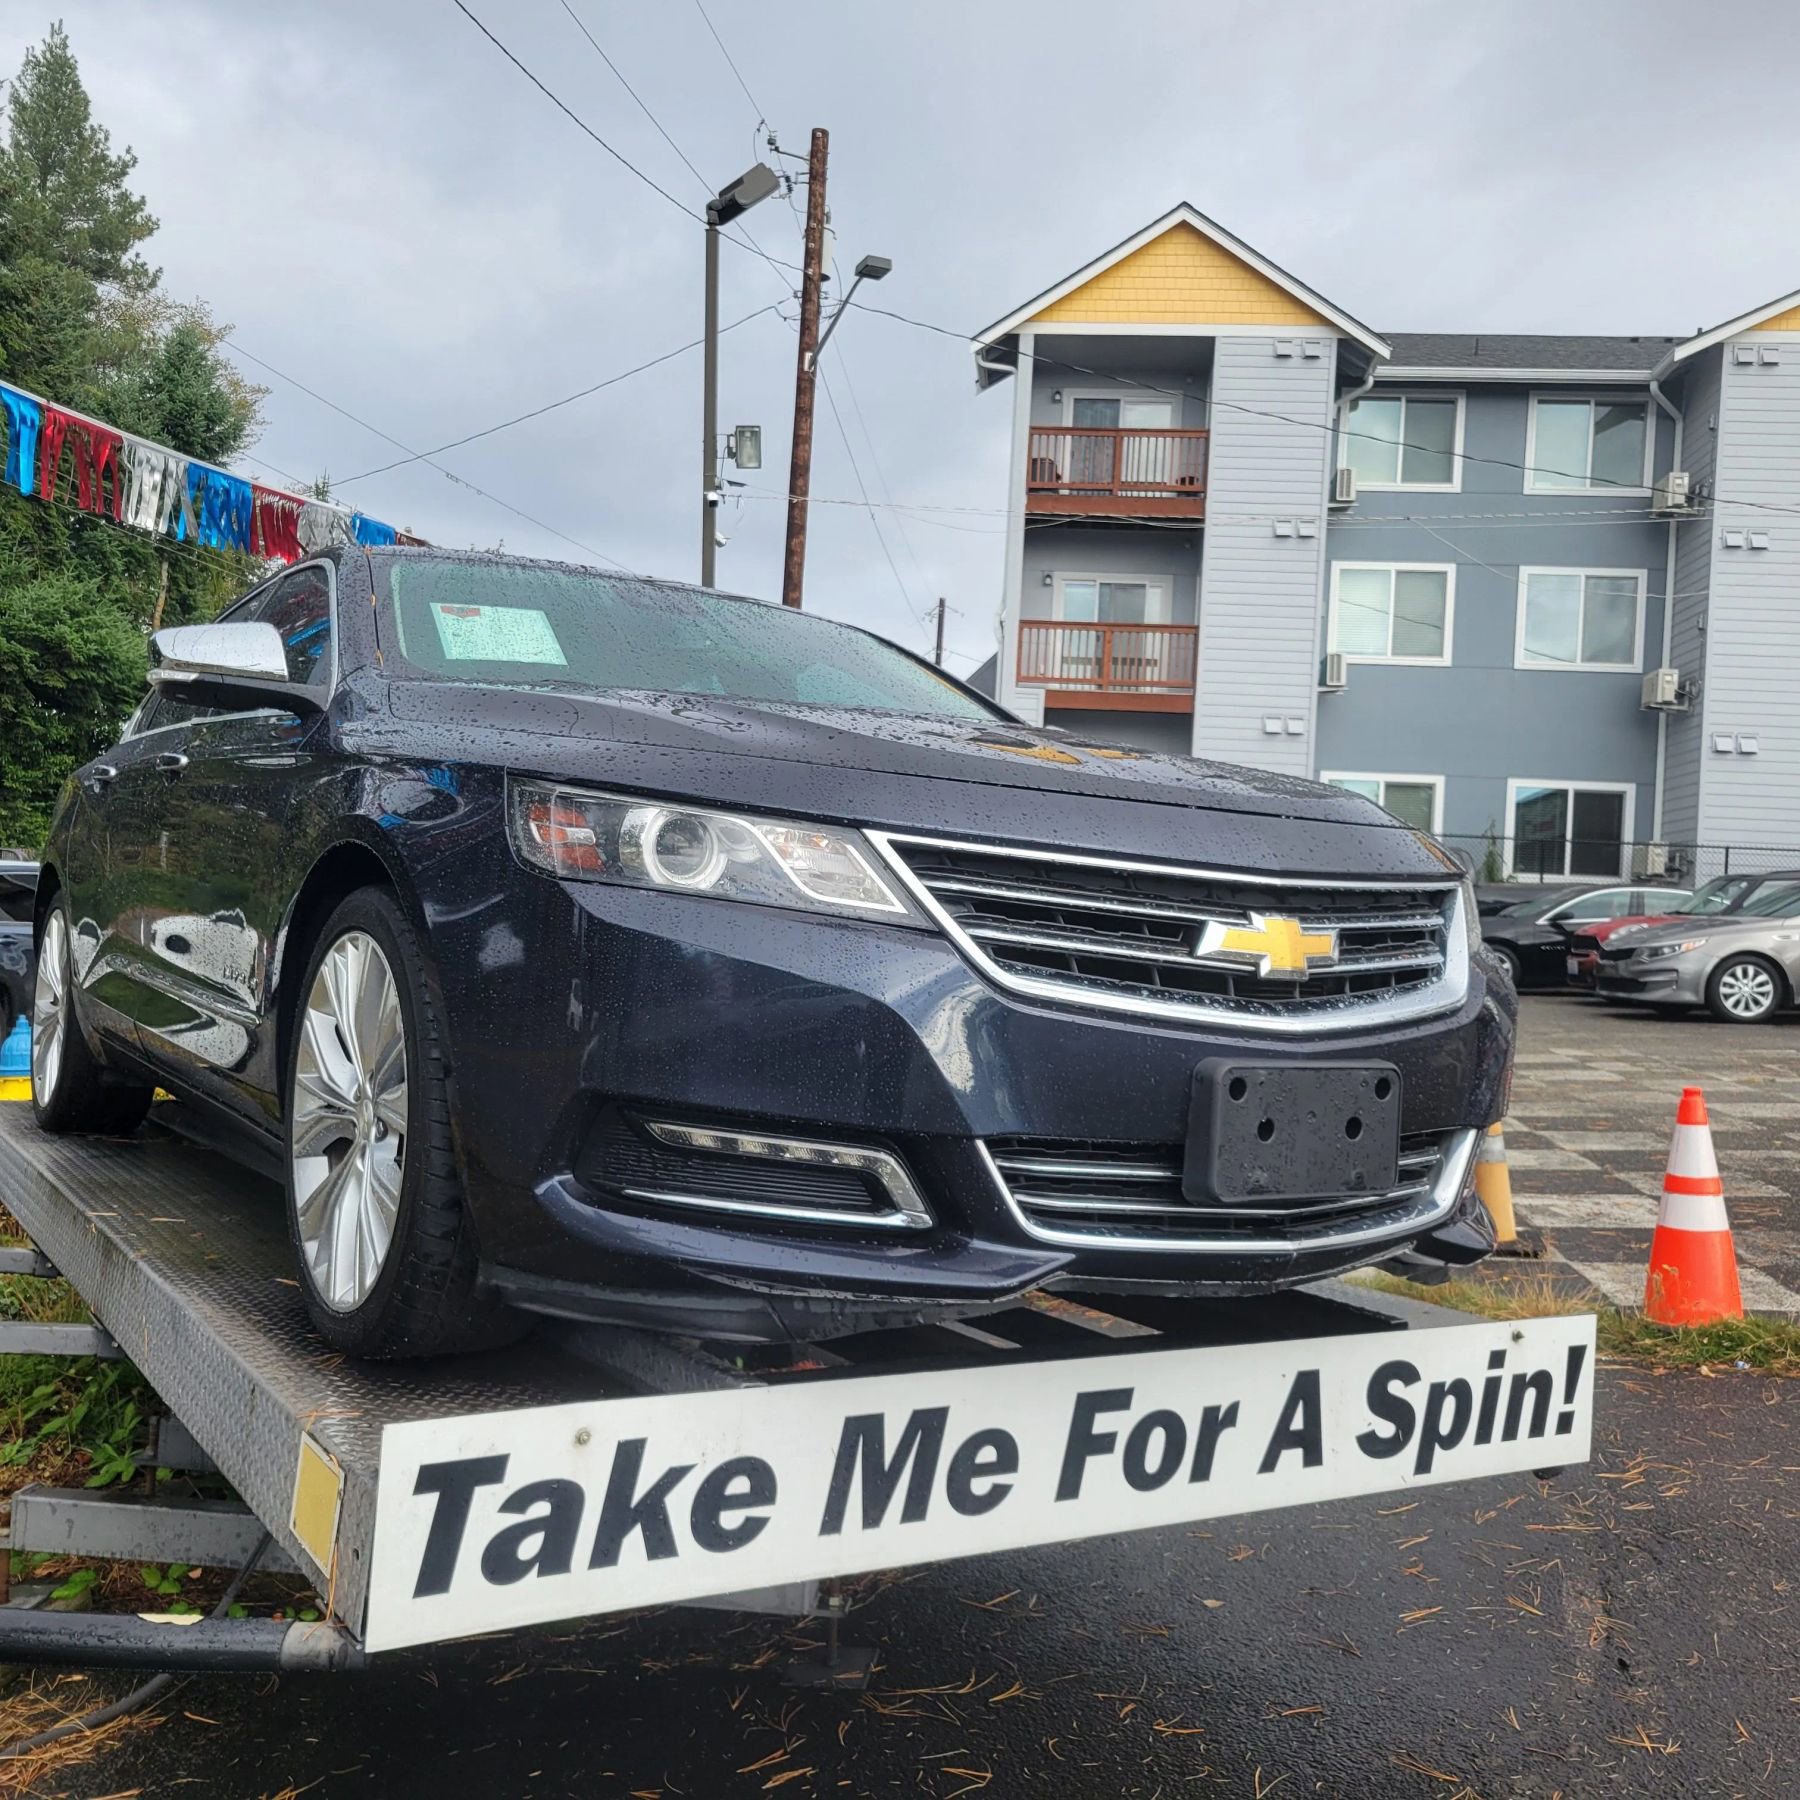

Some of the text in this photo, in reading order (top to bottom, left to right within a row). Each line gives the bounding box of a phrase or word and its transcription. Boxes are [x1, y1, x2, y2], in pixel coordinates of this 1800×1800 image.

[413, 1345, 1586, 1598] Take Me For A Spin!
